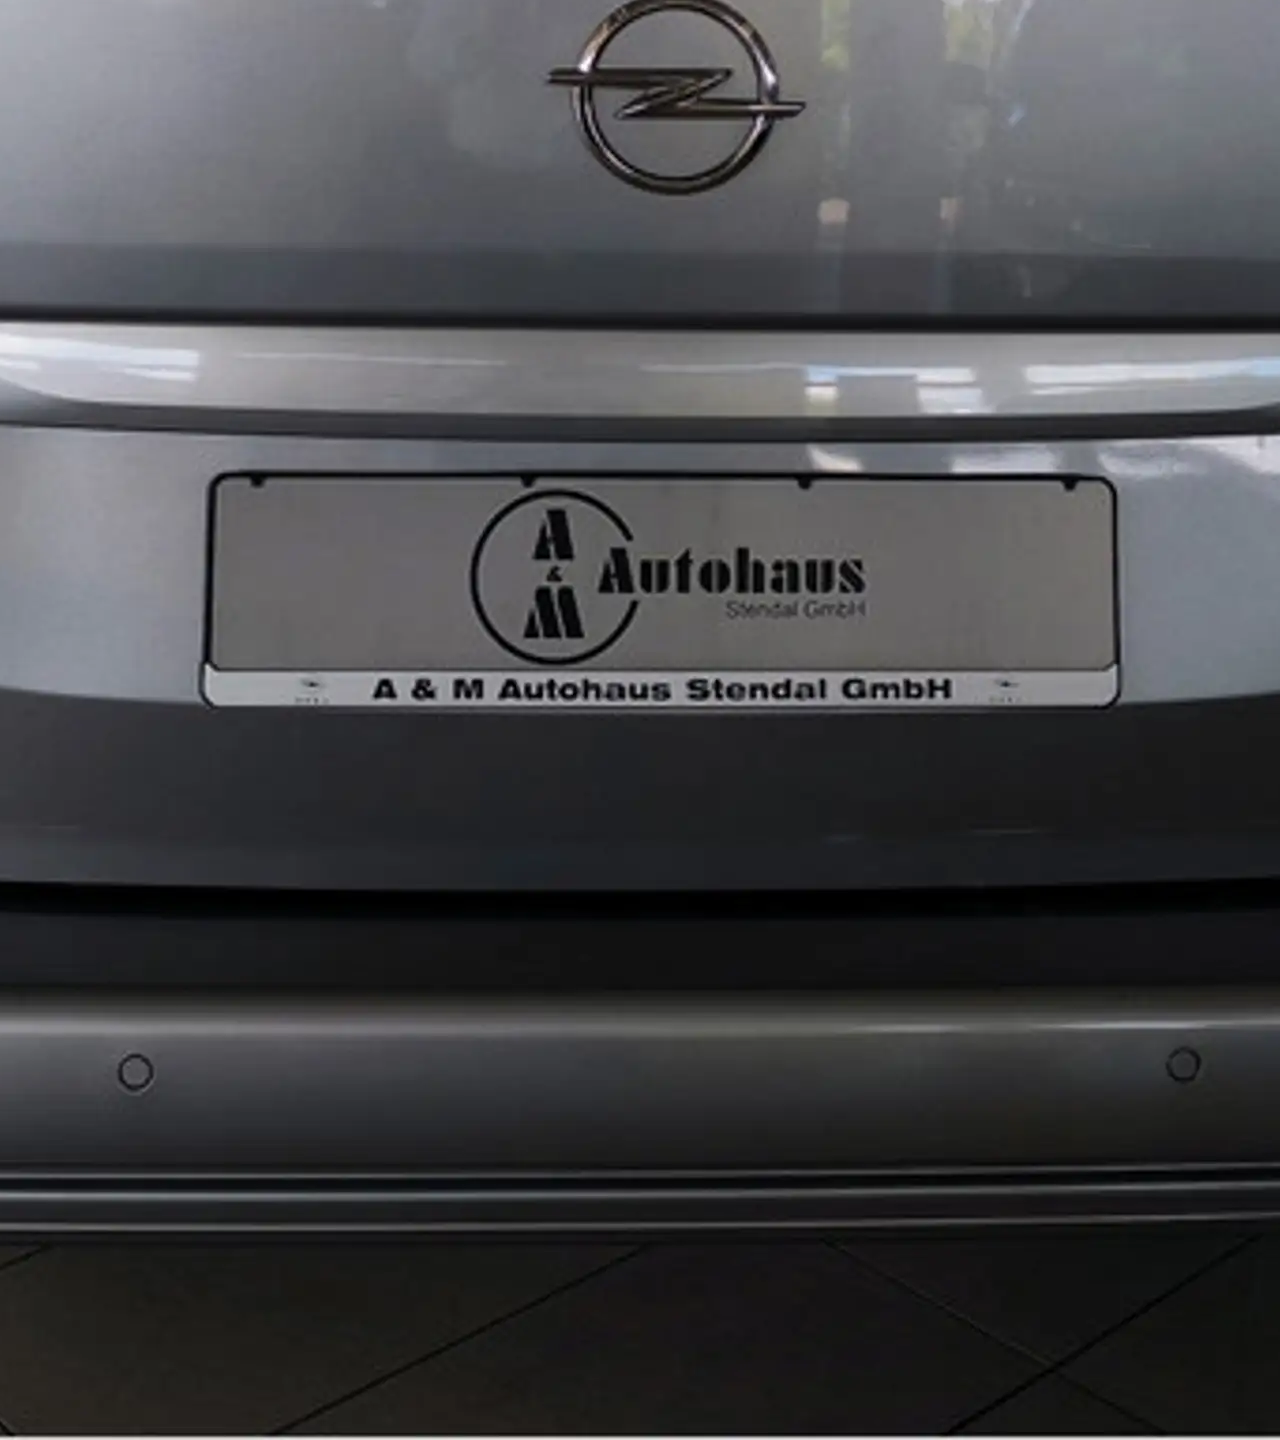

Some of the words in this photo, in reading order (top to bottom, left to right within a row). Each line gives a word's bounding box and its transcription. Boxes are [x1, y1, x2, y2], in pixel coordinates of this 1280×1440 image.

[532, 509, 574, 561] A
[545, 566, 564, 584] &
[598, 547, 867, 596] Autohaus
[523, 586, 586, 639] M
[725, 600, 799, 620] Stendal
[803, 601, 868, 620] GmbH
[372, 679, 398, 700] A
[410, 678, 437, 700] &
[452, 679, 486, 700] M
[498, 678, 673, 701] Autohaus
[686, 677, 829, 702] Stendal
[842, 677, 953, 701] GmbH
